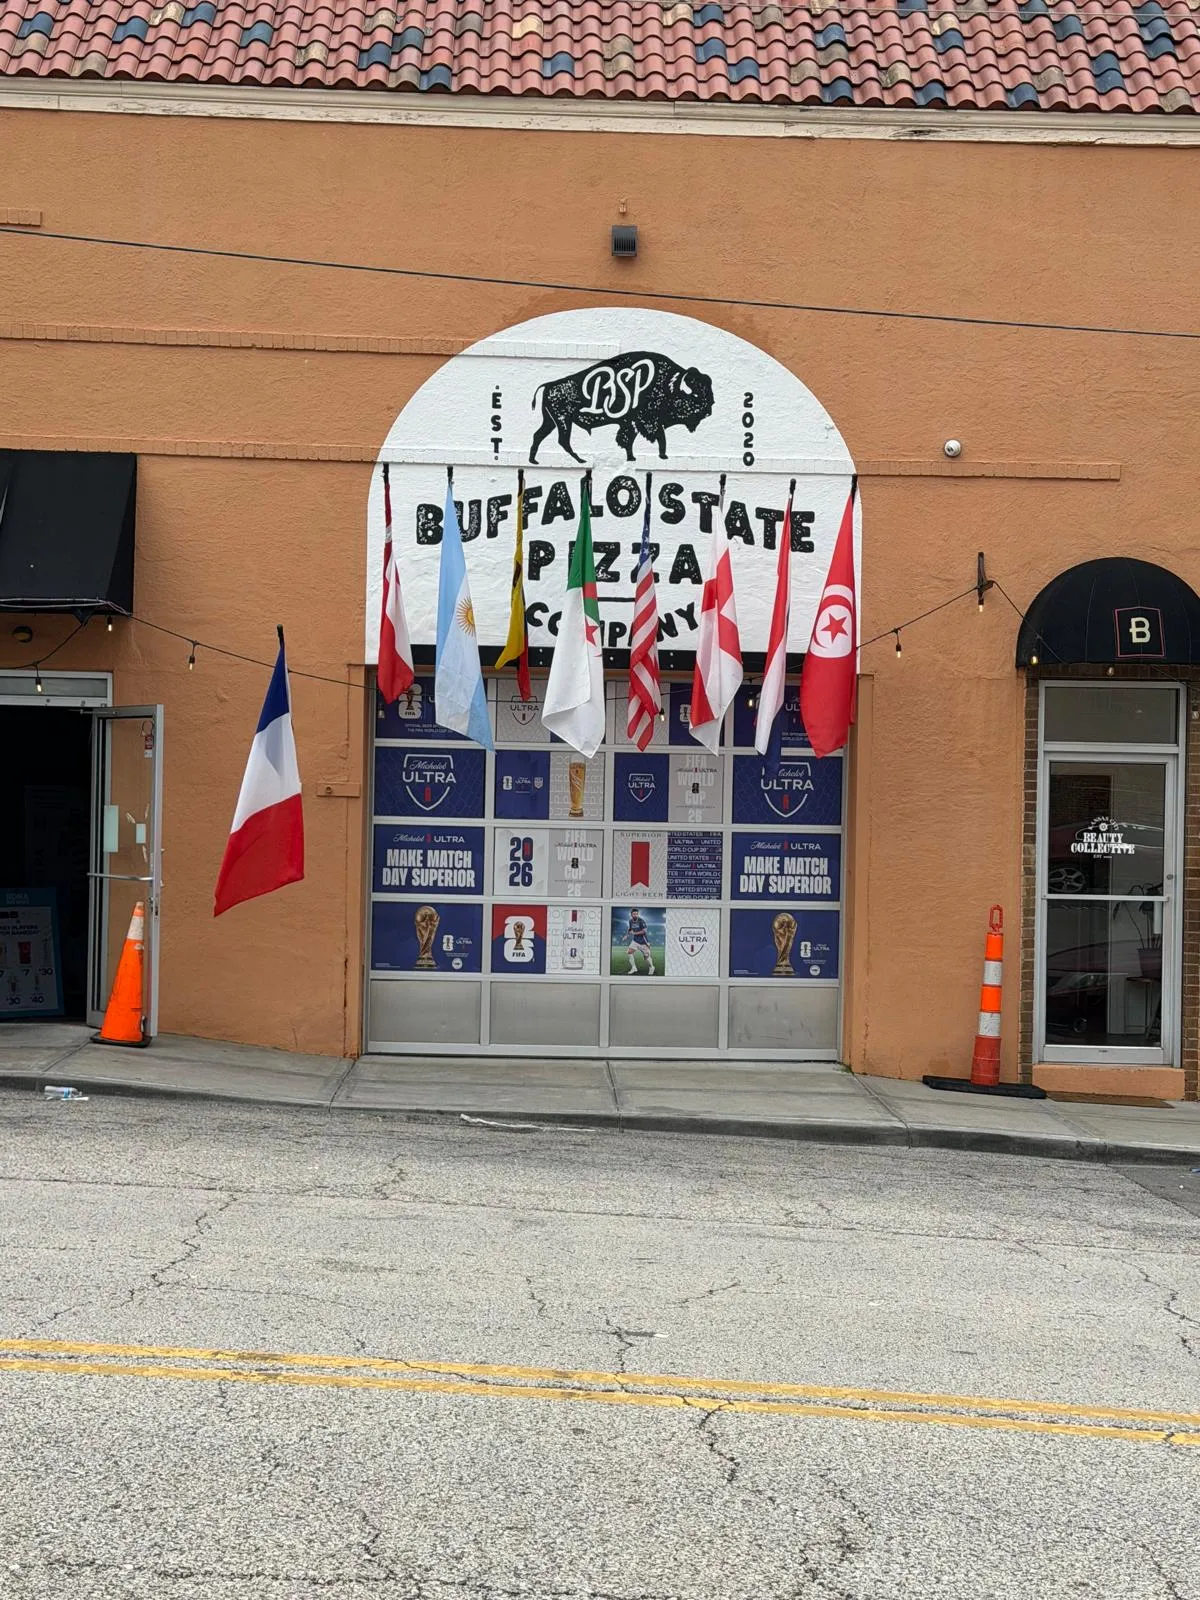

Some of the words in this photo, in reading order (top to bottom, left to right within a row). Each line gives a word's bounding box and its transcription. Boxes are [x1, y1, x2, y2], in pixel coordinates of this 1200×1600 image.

[742, 392, 754, 466] 2020
[658, 482, 815, 553] STATE
[1129, 617, 1151, 643] B
[409, 759, 448, 771] Michelob
[402, 772, 457, 784] ULTRA
[628, 781, 656, 789] ULTRA
[761, 779, 814, 790] ULTRA
[685, 790, 706, 805] CUP
[1087, 815, 1109, 831] KANSAS
[1109, 818, 1120, 831] CITY
[393, 833, 424, 843] Michelob
[750, 840, 781, 850] Michelob
[1083, 832, 1124, 844] BEAUTY
[509, 837, 534, 861] 20
[1070, 842, 1136, 855] COLLECTIVE
[386, 849, 423, 867] MAKE
[427, 850, 473, 868] MATCH
[744, 856, 780, 874] MAKE
[783, 857, 828, 876] MATCH
[382, 868, 409, 886] DAY
[411, 869, 476, 888] SUPERIOR
[508, 862, 533, 887] 26
[564, 865, 585, 880] CUP
[739, 876, 766, 893] DAY
[768, 877, 832, 895] SUPERIOR
